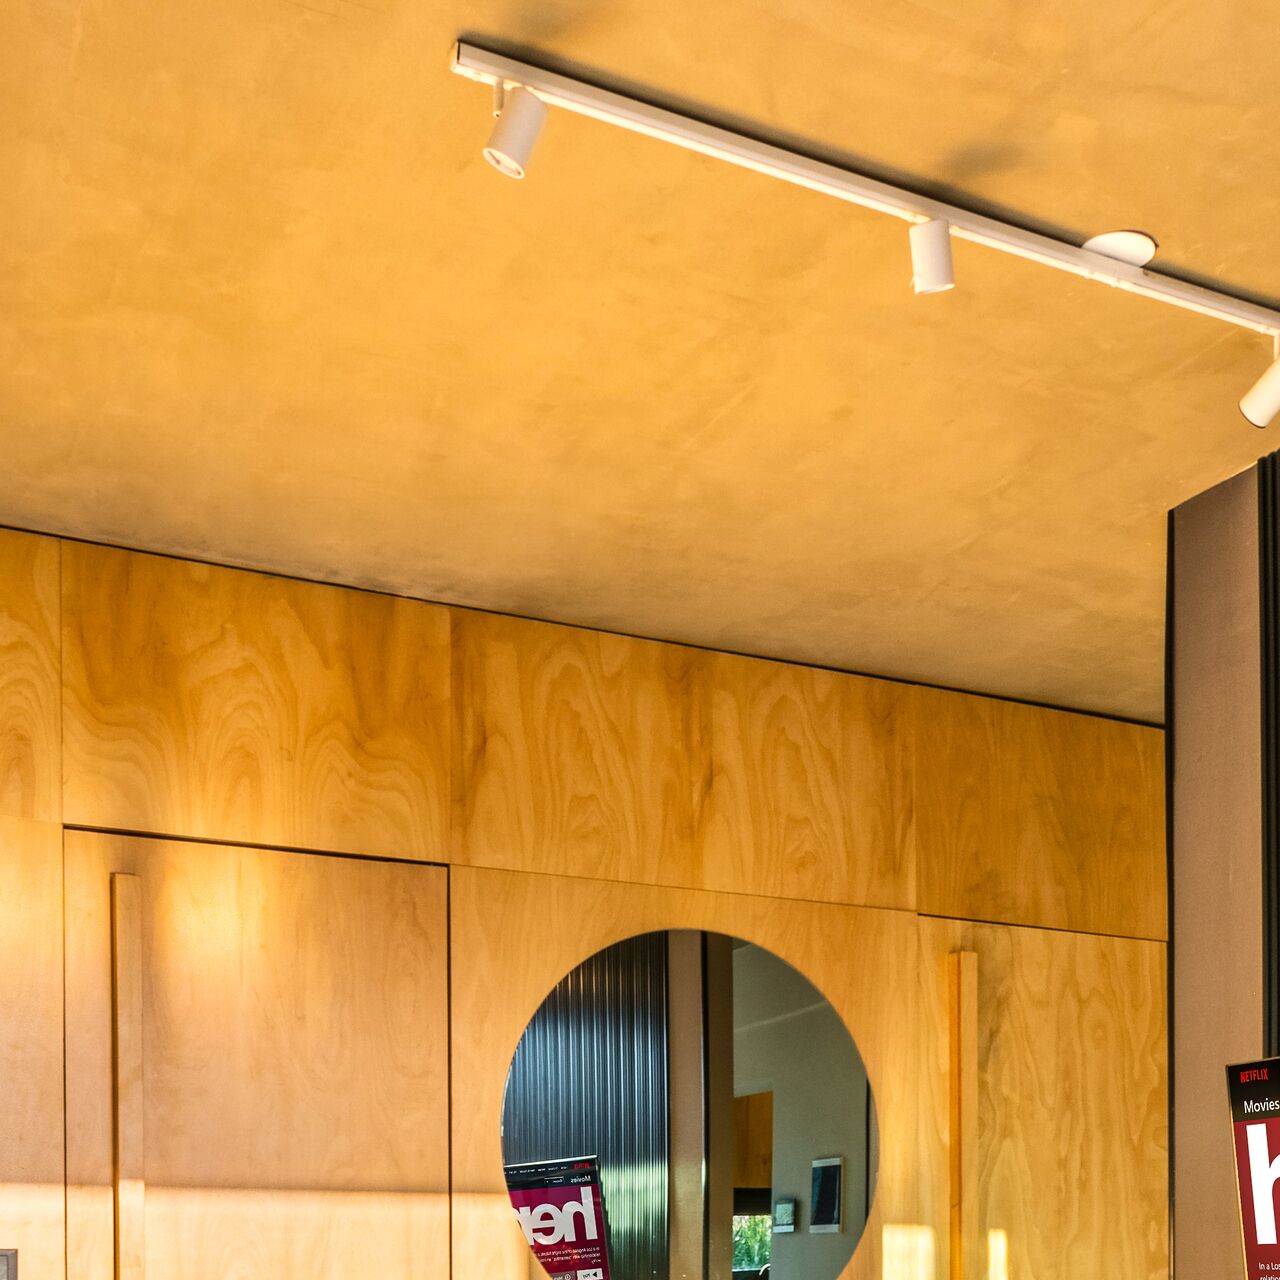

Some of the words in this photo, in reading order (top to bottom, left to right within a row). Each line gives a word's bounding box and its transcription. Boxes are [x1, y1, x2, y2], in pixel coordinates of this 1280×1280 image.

[1240, 1068, 1269, 1084] NETFLIX
[1244, 1098, 1280, 1113] Movies
[1259, 1262, 1265, 1270] In
[1271, 1262, 1280, 1270] Los
